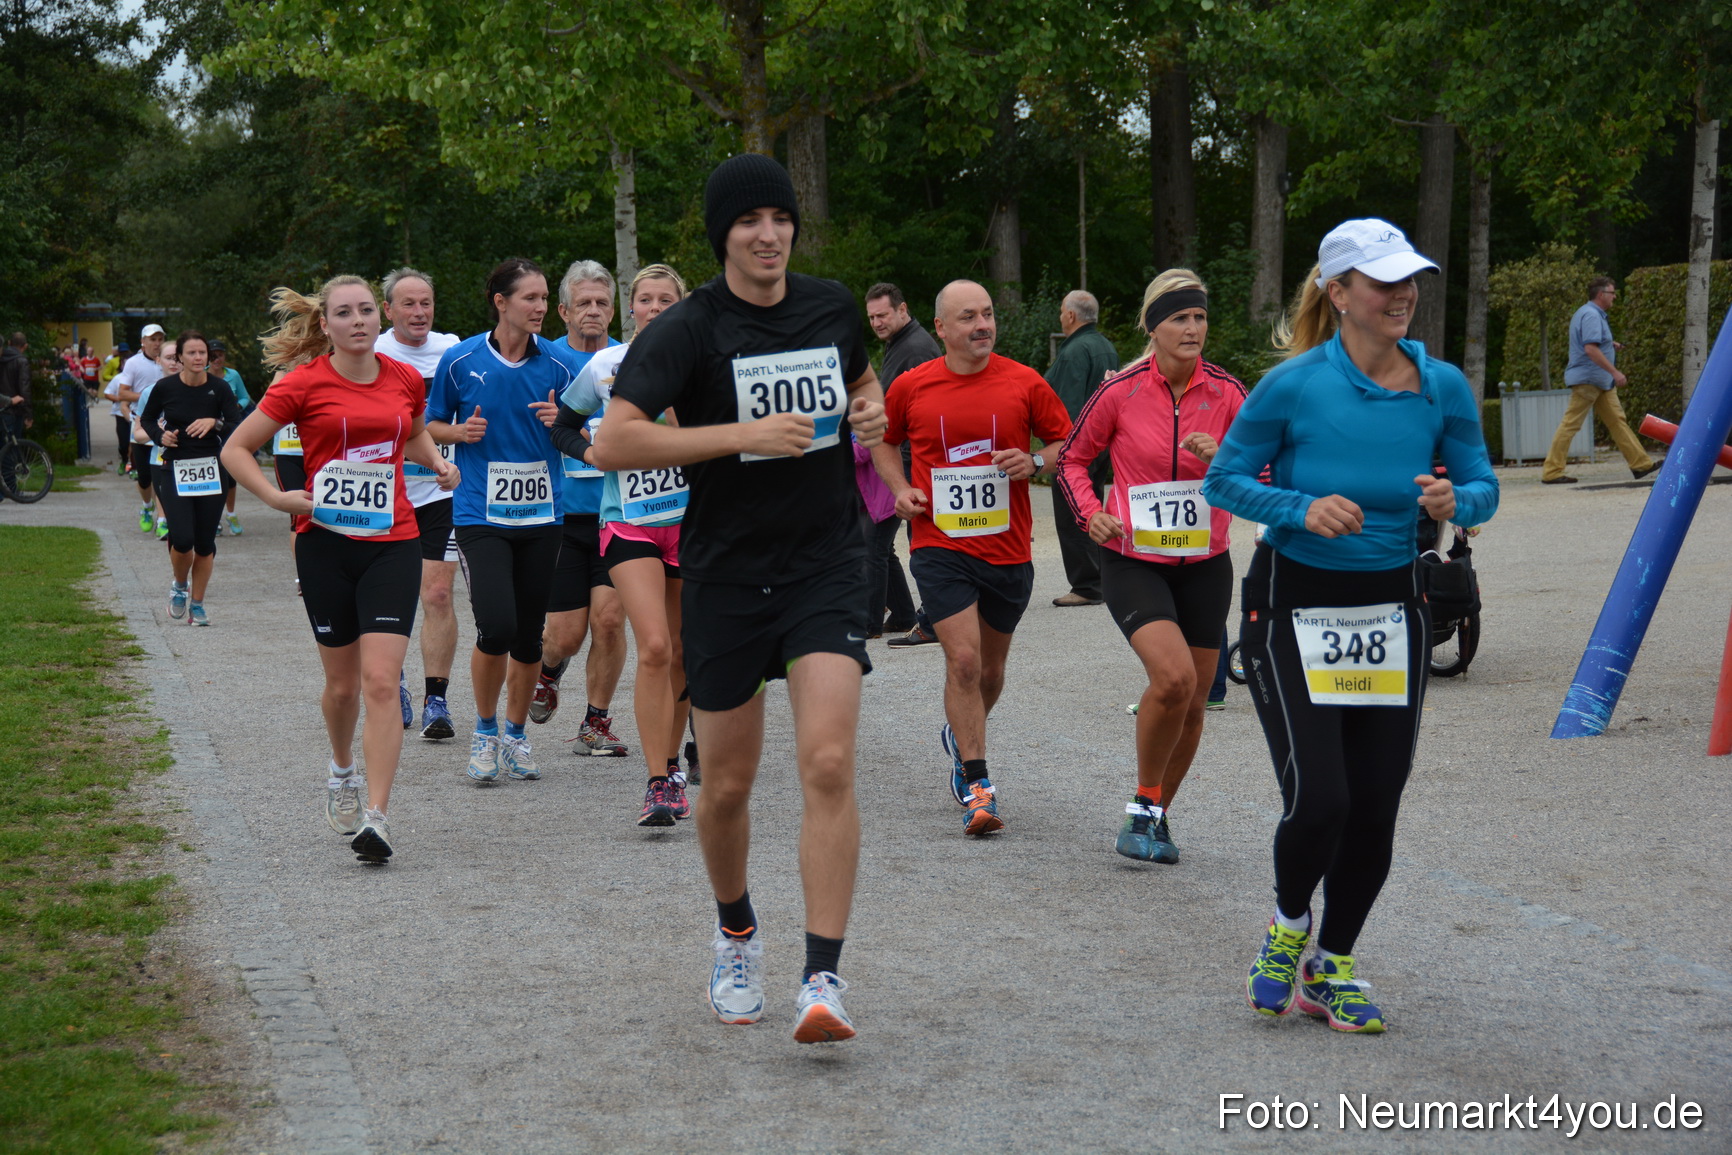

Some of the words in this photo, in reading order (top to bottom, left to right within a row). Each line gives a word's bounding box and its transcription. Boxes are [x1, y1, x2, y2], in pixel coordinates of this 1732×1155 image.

[737, 366, 773, 379] PARTL
[775, 360, 824, 374] Neumarkt
[750, 374, 838, 420] 3005
[360, 447, 381, 458] DEHN
[960, 445, 980, 456] DEHN
[179, 466, 216, 482] 2549
[322, 466, 345, 475] ARTL
[346, 468, 383, 478] Neumarkt
[489, 467, 514, 475] PARTL
[514, 467, 542, 476] Neumarkt
[960, 472, 996, 481] Neumarkt
[495, 476, 548, 502] 2096
[627, 466, 688, 499] 2528
[322, 477, 388, 509] 2546
[949, 482, 996, 510] 318
[1131, 491, 1159, 501] PARTL
[1159, 488, 1196, 498] Neumarkt
[505, 507, 538, 517] Kristina
[642, 498, 679, 513] Yvonne
[335, 512, 371, 526] Annika
[1148, 499, 1198, 528] 178
[958, 516, 988, 527] Mario
[1161, 534, 1189, 547] Birgit
[1297, 618, 1333, 627] PARTL
[1336, 616, 1387, 627] Neumarkt
[1321, 629, 1387, 665] 348
[1334, 677, 1371, 691] Heidi
